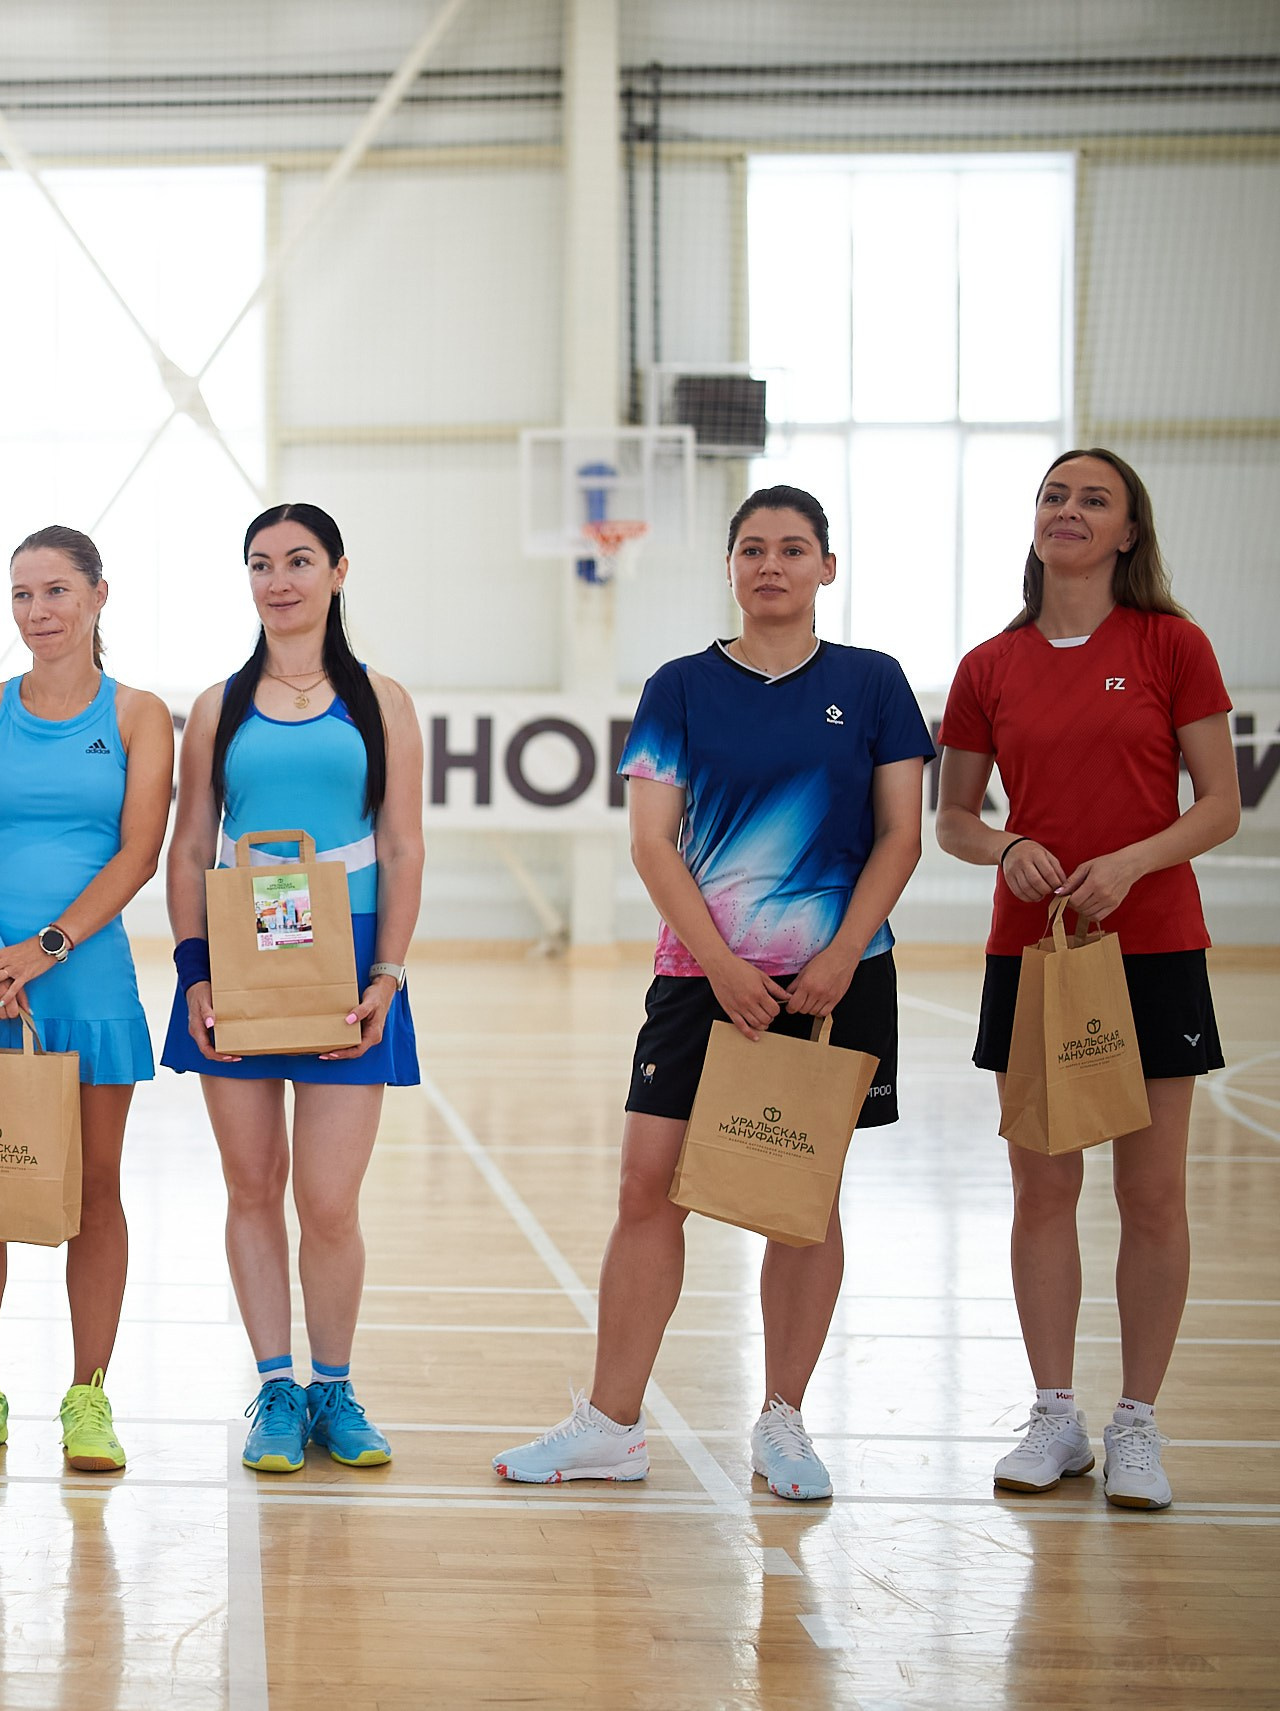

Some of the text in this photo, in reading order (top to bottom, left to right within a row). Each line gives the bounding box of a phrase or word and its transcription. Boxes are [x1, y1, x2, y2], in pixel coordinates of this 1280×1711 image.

[1105, 677, 1126, 691] FZ
[1057, 1038, 1126, 1064] МАНУФАКТУРА
[1062, 1029, 1121, 1052] УРАЛЬСКАЯ
[718, 1122, 816, 1155] МАНУФАКТУРА
[730, 1115, 808, 1143] УРАЛЬСКАЯ
